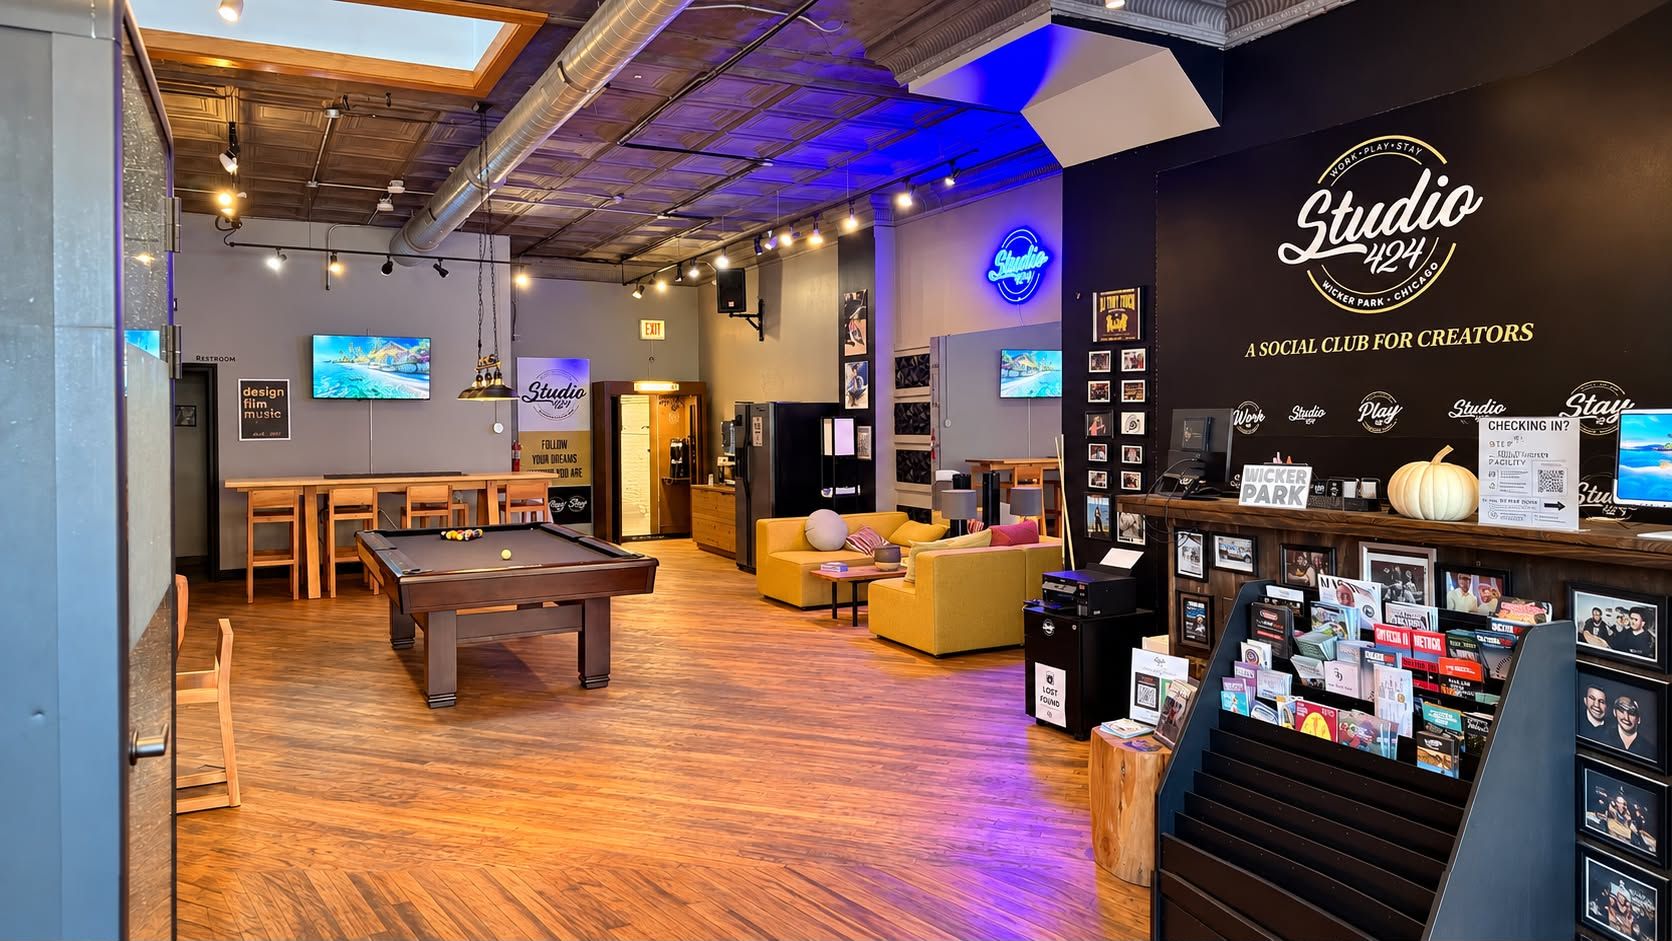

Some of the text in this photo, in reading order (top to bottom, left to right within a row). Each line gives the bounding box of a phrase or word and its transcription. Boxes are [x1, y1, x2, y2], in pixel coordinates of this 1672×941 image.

[1330, 142, 1423, 178] WORK PLAY STAY
[1277, 167, 1483, 264] Studio
[988, 244, 1049, 281] Studio
[1363, 236, 1427, 275] 424
[1321, 261, 1440, 308] WICKER PARK CHICAGO
[645, 322, 661, 336] EXIT
[1245, 322, 1534, 358] A SOCIAL CLUB FOR CREATORS
[243, 386, 285, 399] design
[521, 381, 587, 403] Studio
[244, 408, 281, 419] music
[1233, 408, 1265, 426] Work
[1288, 404, 1326, 421] Studio
[1357, 401, 1403, 424] Play
[1448, 399, 1507, 418] Studio
[1559, 392, 1636, 424] Stay
[1488, 420, 1570, 431] CHECKING IN?
[541, 439, 568, 450] FOLLOW
[532, 453, 577, 465] YOUR DREAMS
[570, 467, 583, 479] ARE
[1243, 467, 1307, 485] WICKER
[1241, 484, 1306, 506] PARK
[1042, 686, 1058, 697] LOST
